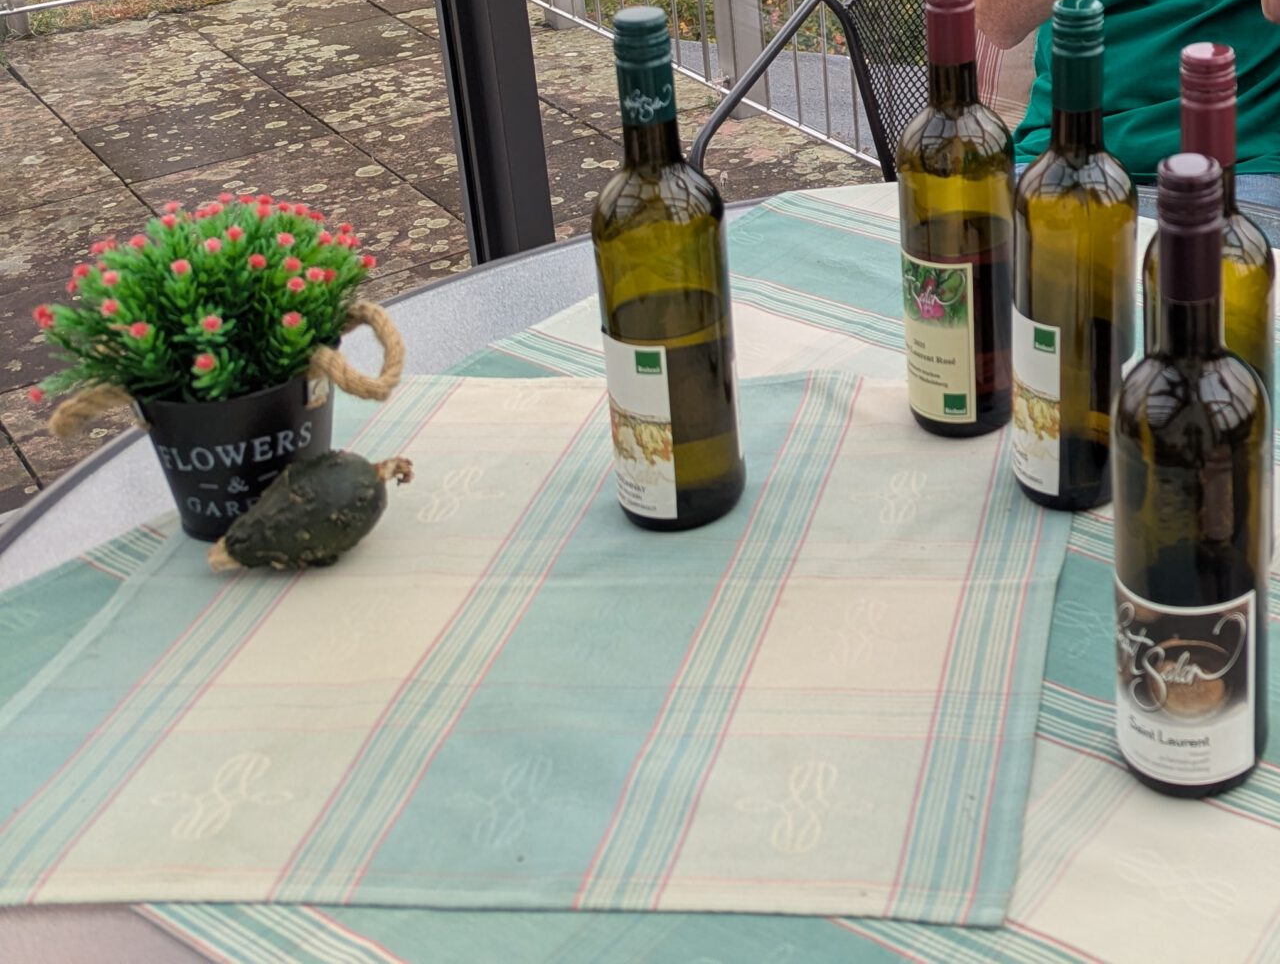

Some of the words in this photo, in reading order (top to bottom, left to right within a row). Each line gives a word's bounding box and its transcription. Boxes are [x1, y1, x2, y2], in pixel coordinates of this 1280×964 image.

[157, 422, 313, 471] FLOWERS
[227, 476, 249, 494] &
[1158, 730, 1210, 748] Laurent
